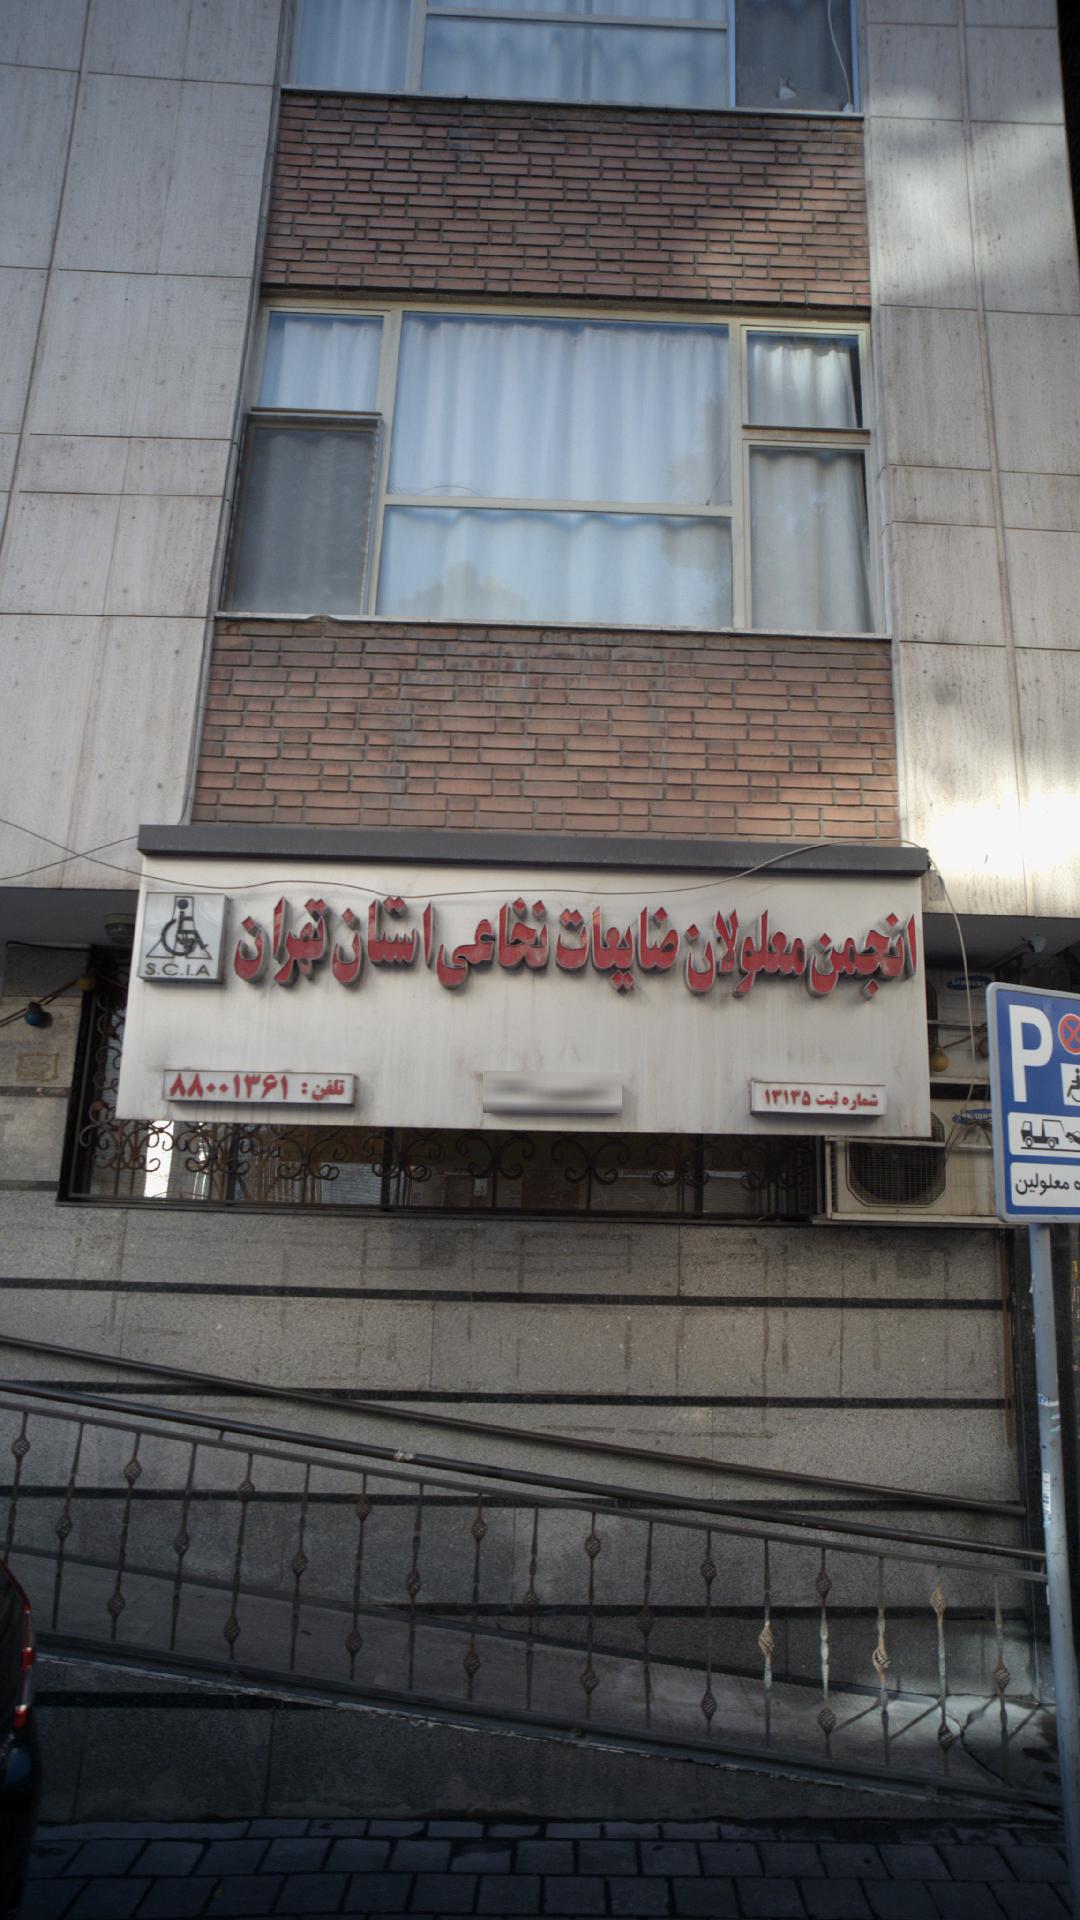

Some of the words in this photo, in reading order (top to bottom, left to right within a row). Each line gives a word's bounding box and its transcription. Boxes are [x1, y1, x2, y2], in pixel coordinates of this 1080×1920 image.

[145, 962, 210, 976] S.C.I.A
[234, 896, 330, 987] تهران
[332, 896, 434, 987] استان
[436, 897, 549, 990] نخاعی
[556, 905, 681, 995] ضایعات
[685, 908, 807, 998] معلولان
[809, 912, 918, 998] انجمن
[170, 1072, 289, 1100] ۸۸۰۰۱۳۶۱
[1008, 1004, 1053, 1102] P
[816, 1090, 839, 1109] ثبت
[842, 1092, 879, 1110] شماره
[1015, 1172, 1070, 1196] معلولین
